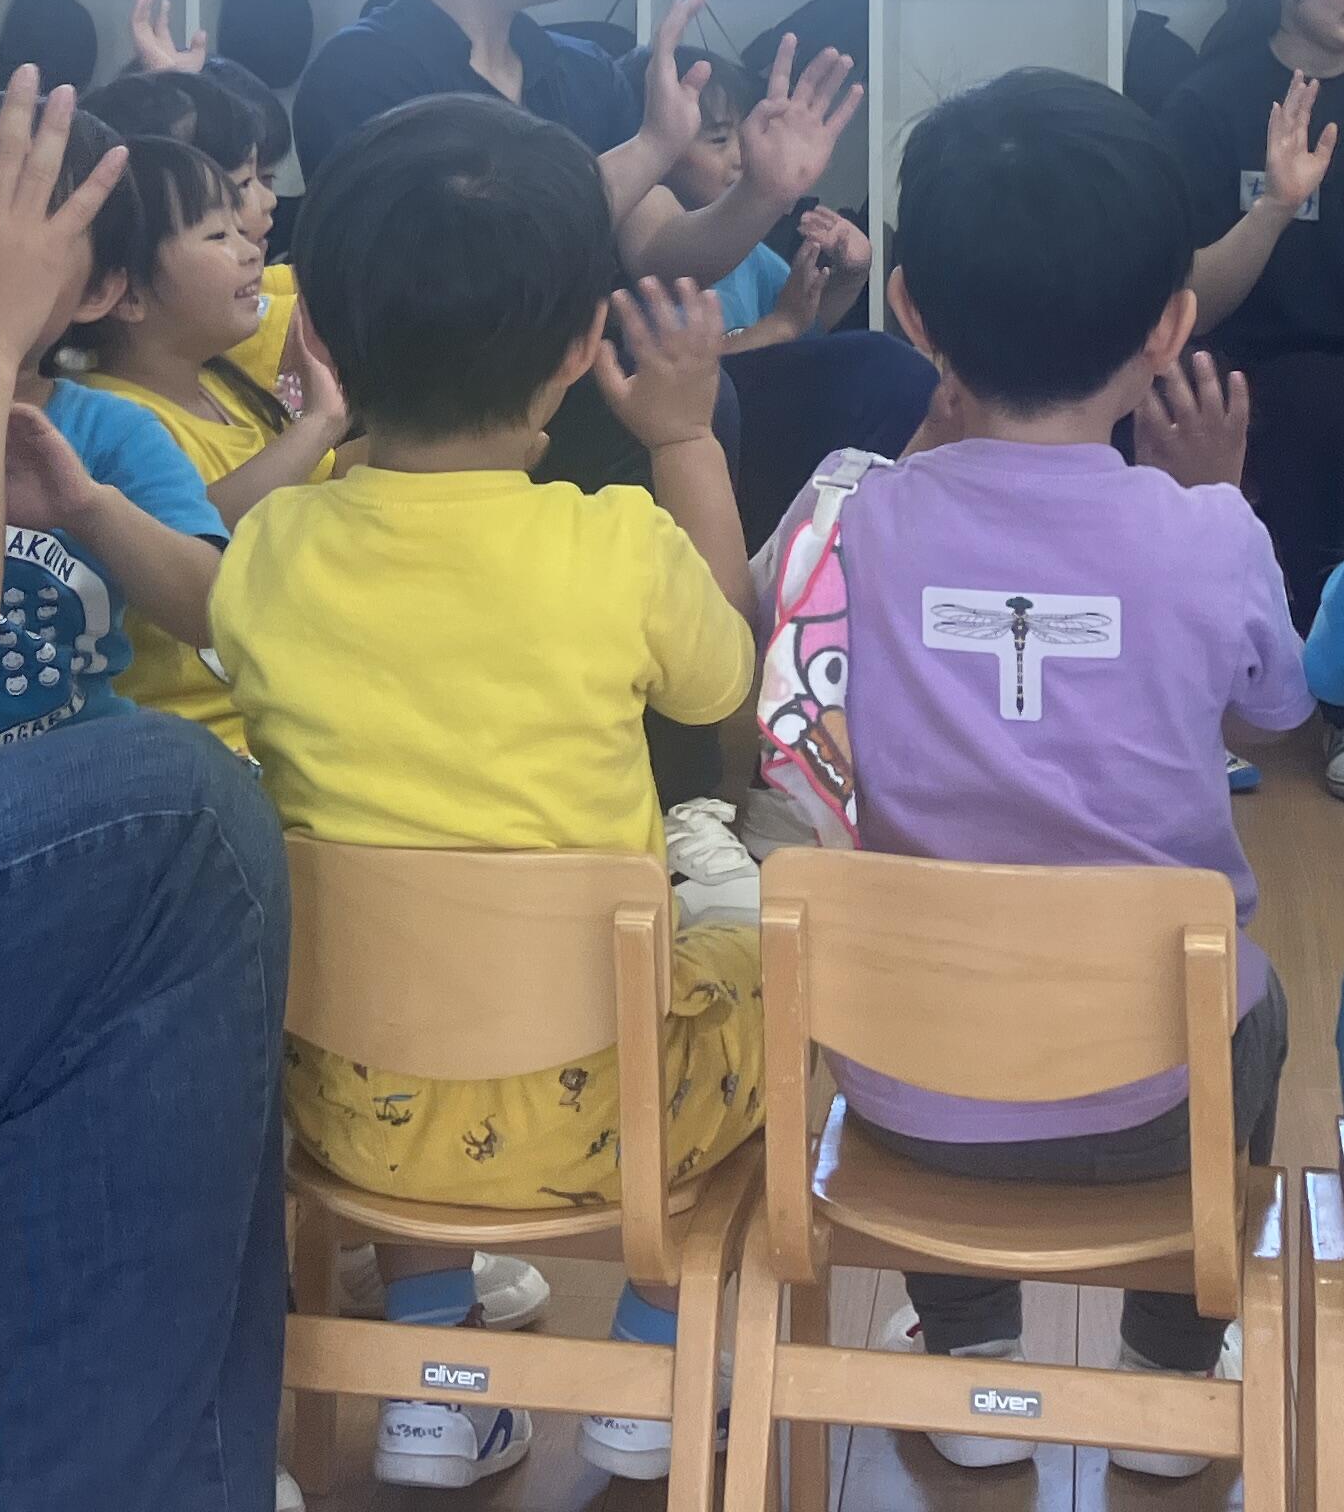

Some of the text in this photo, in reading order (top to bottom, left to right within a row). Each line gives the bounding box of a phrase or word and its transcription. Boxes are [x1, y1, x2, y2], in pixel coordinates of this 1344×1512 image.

[7, 530, 78, 583] AKUIN
[424, 1364, 485, 1385] oliver
[974, 1389, 1039, 1411] oliver
